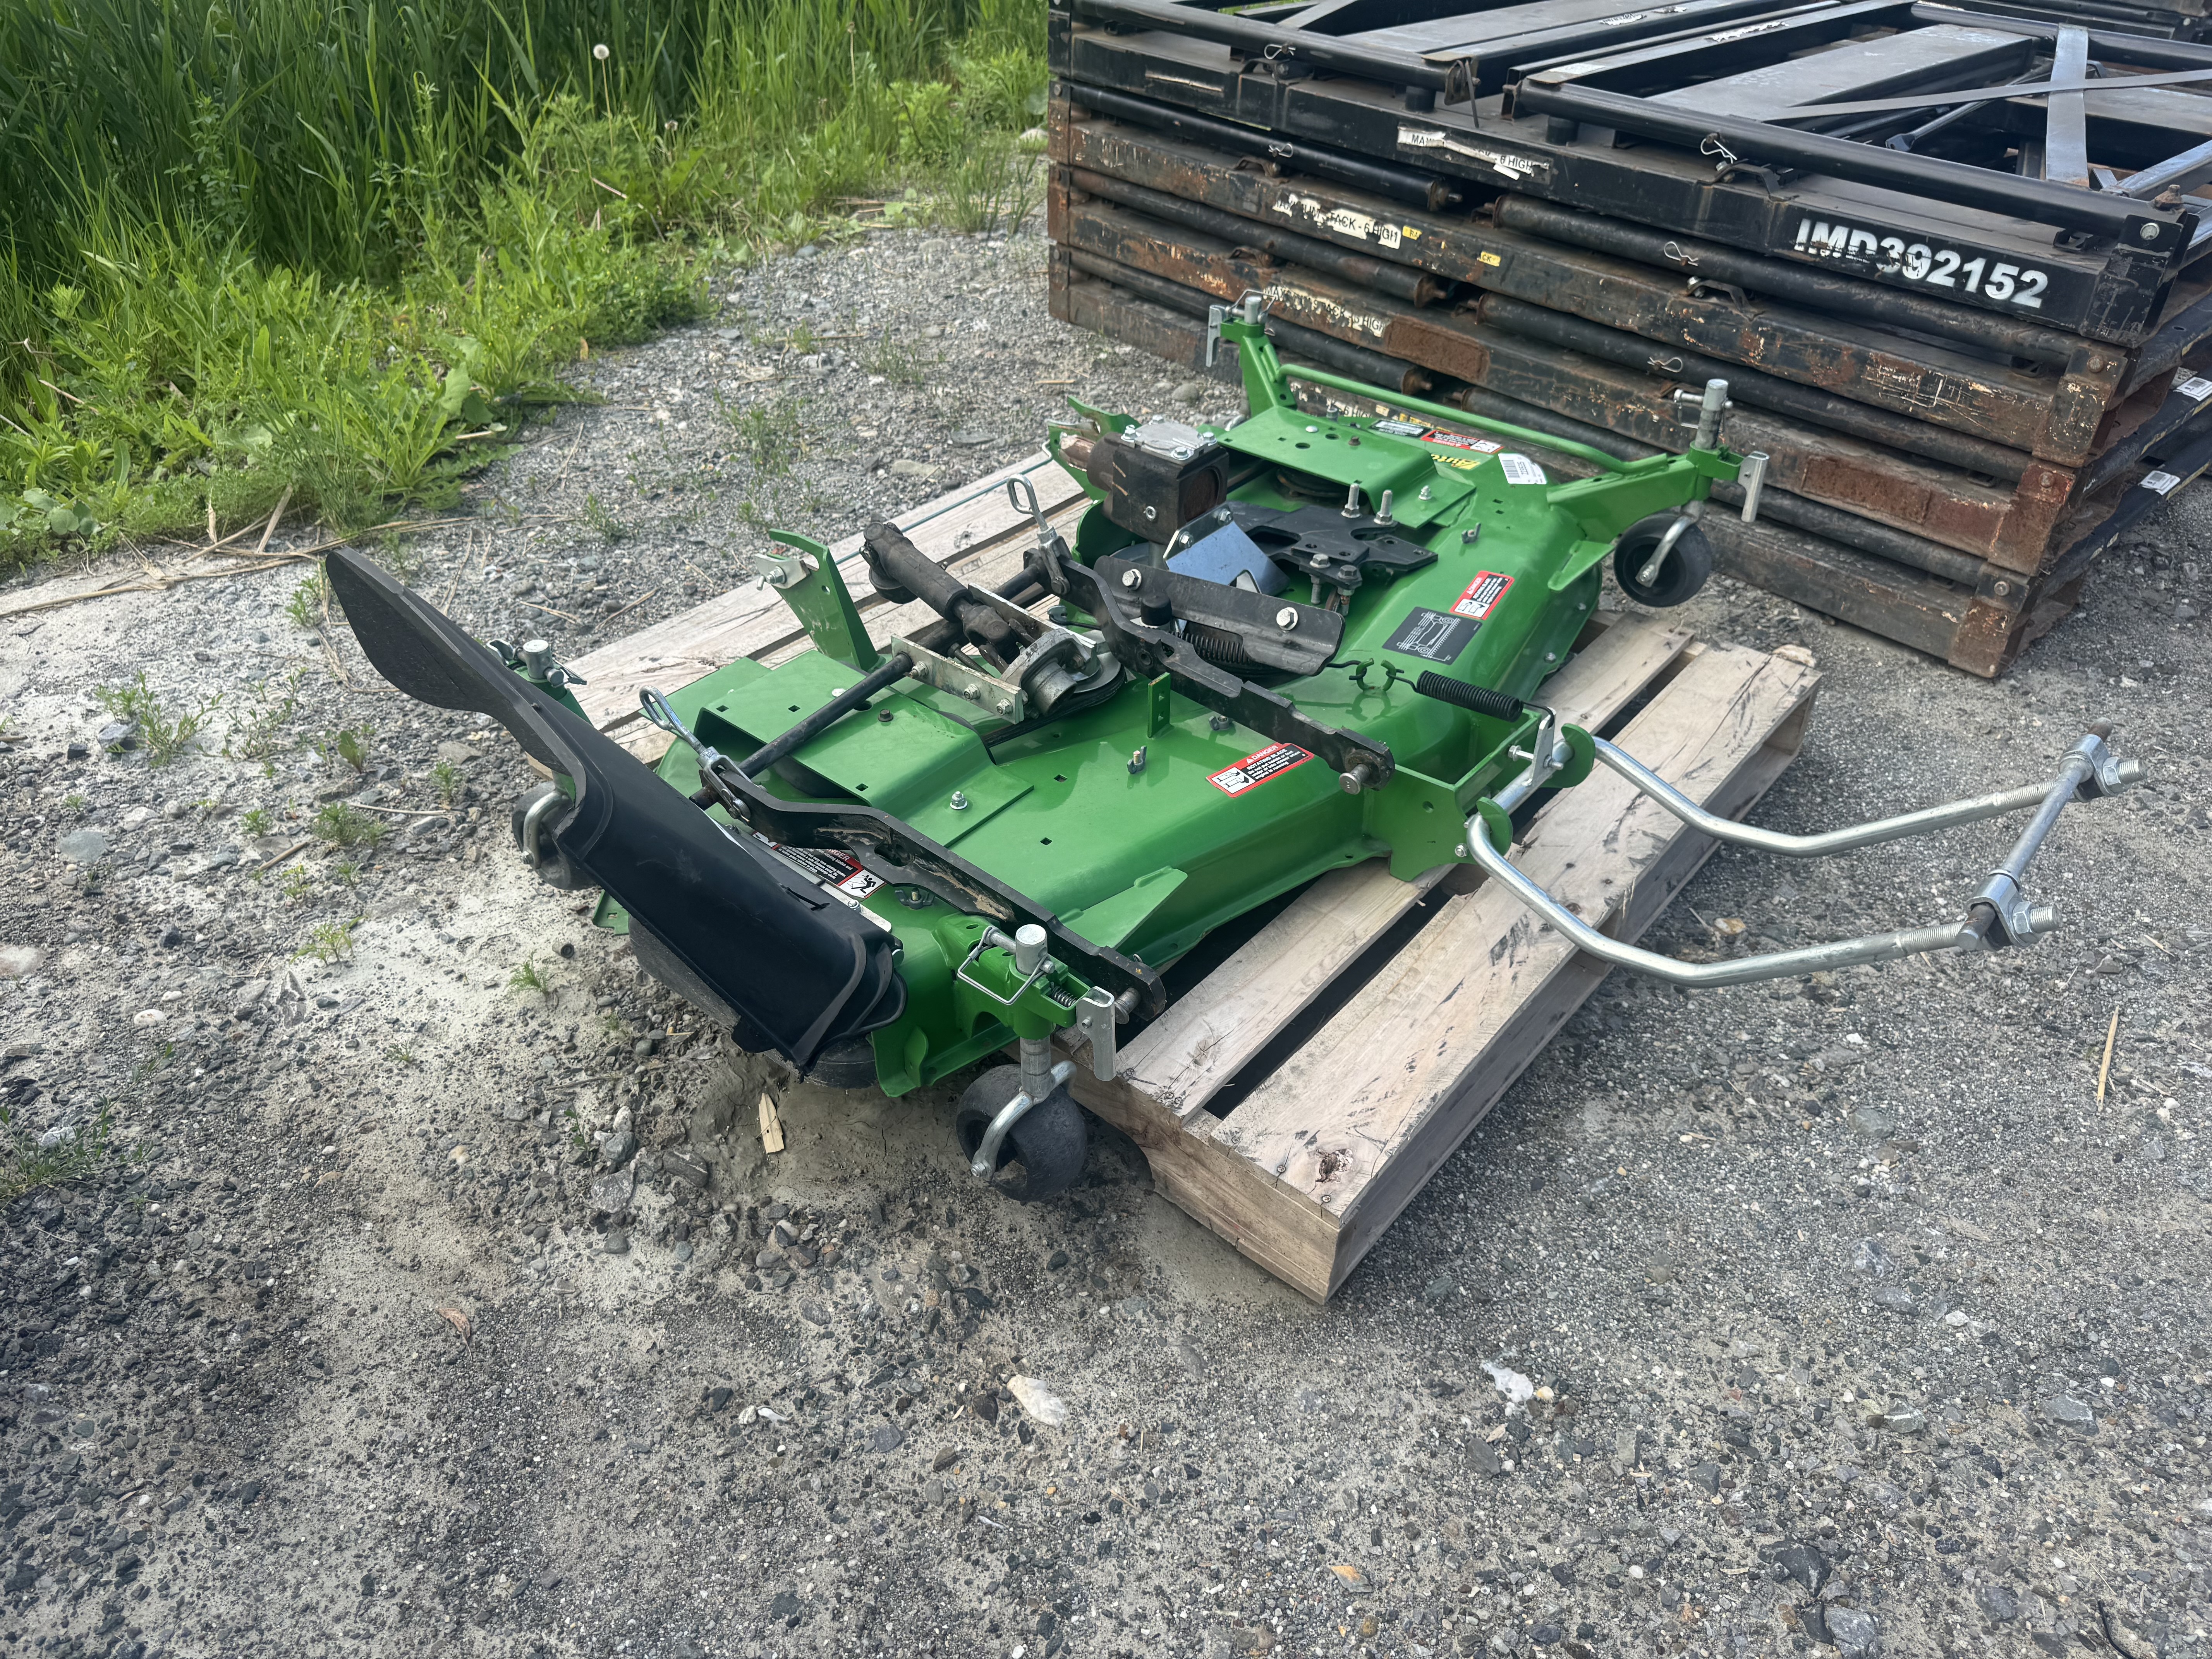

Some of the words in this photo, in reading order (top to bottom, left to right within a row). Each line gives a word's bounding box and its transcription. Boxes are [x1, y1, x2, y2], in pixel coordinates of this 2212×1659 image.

[1508, 156, 1533, 170] HIGH
[1324, 211, 1356, 231] TACK
[1364, 223, 1370, 233] 6
[1373, 224, 1398, 243] HIGH
[1794, 218, 2048, 308] IMD392152
[1247, 756, 1272, 770] ROTATING
[1270, 748, 1288, 759] BLADE
[1251, 745, 1279, 760] DANGER
